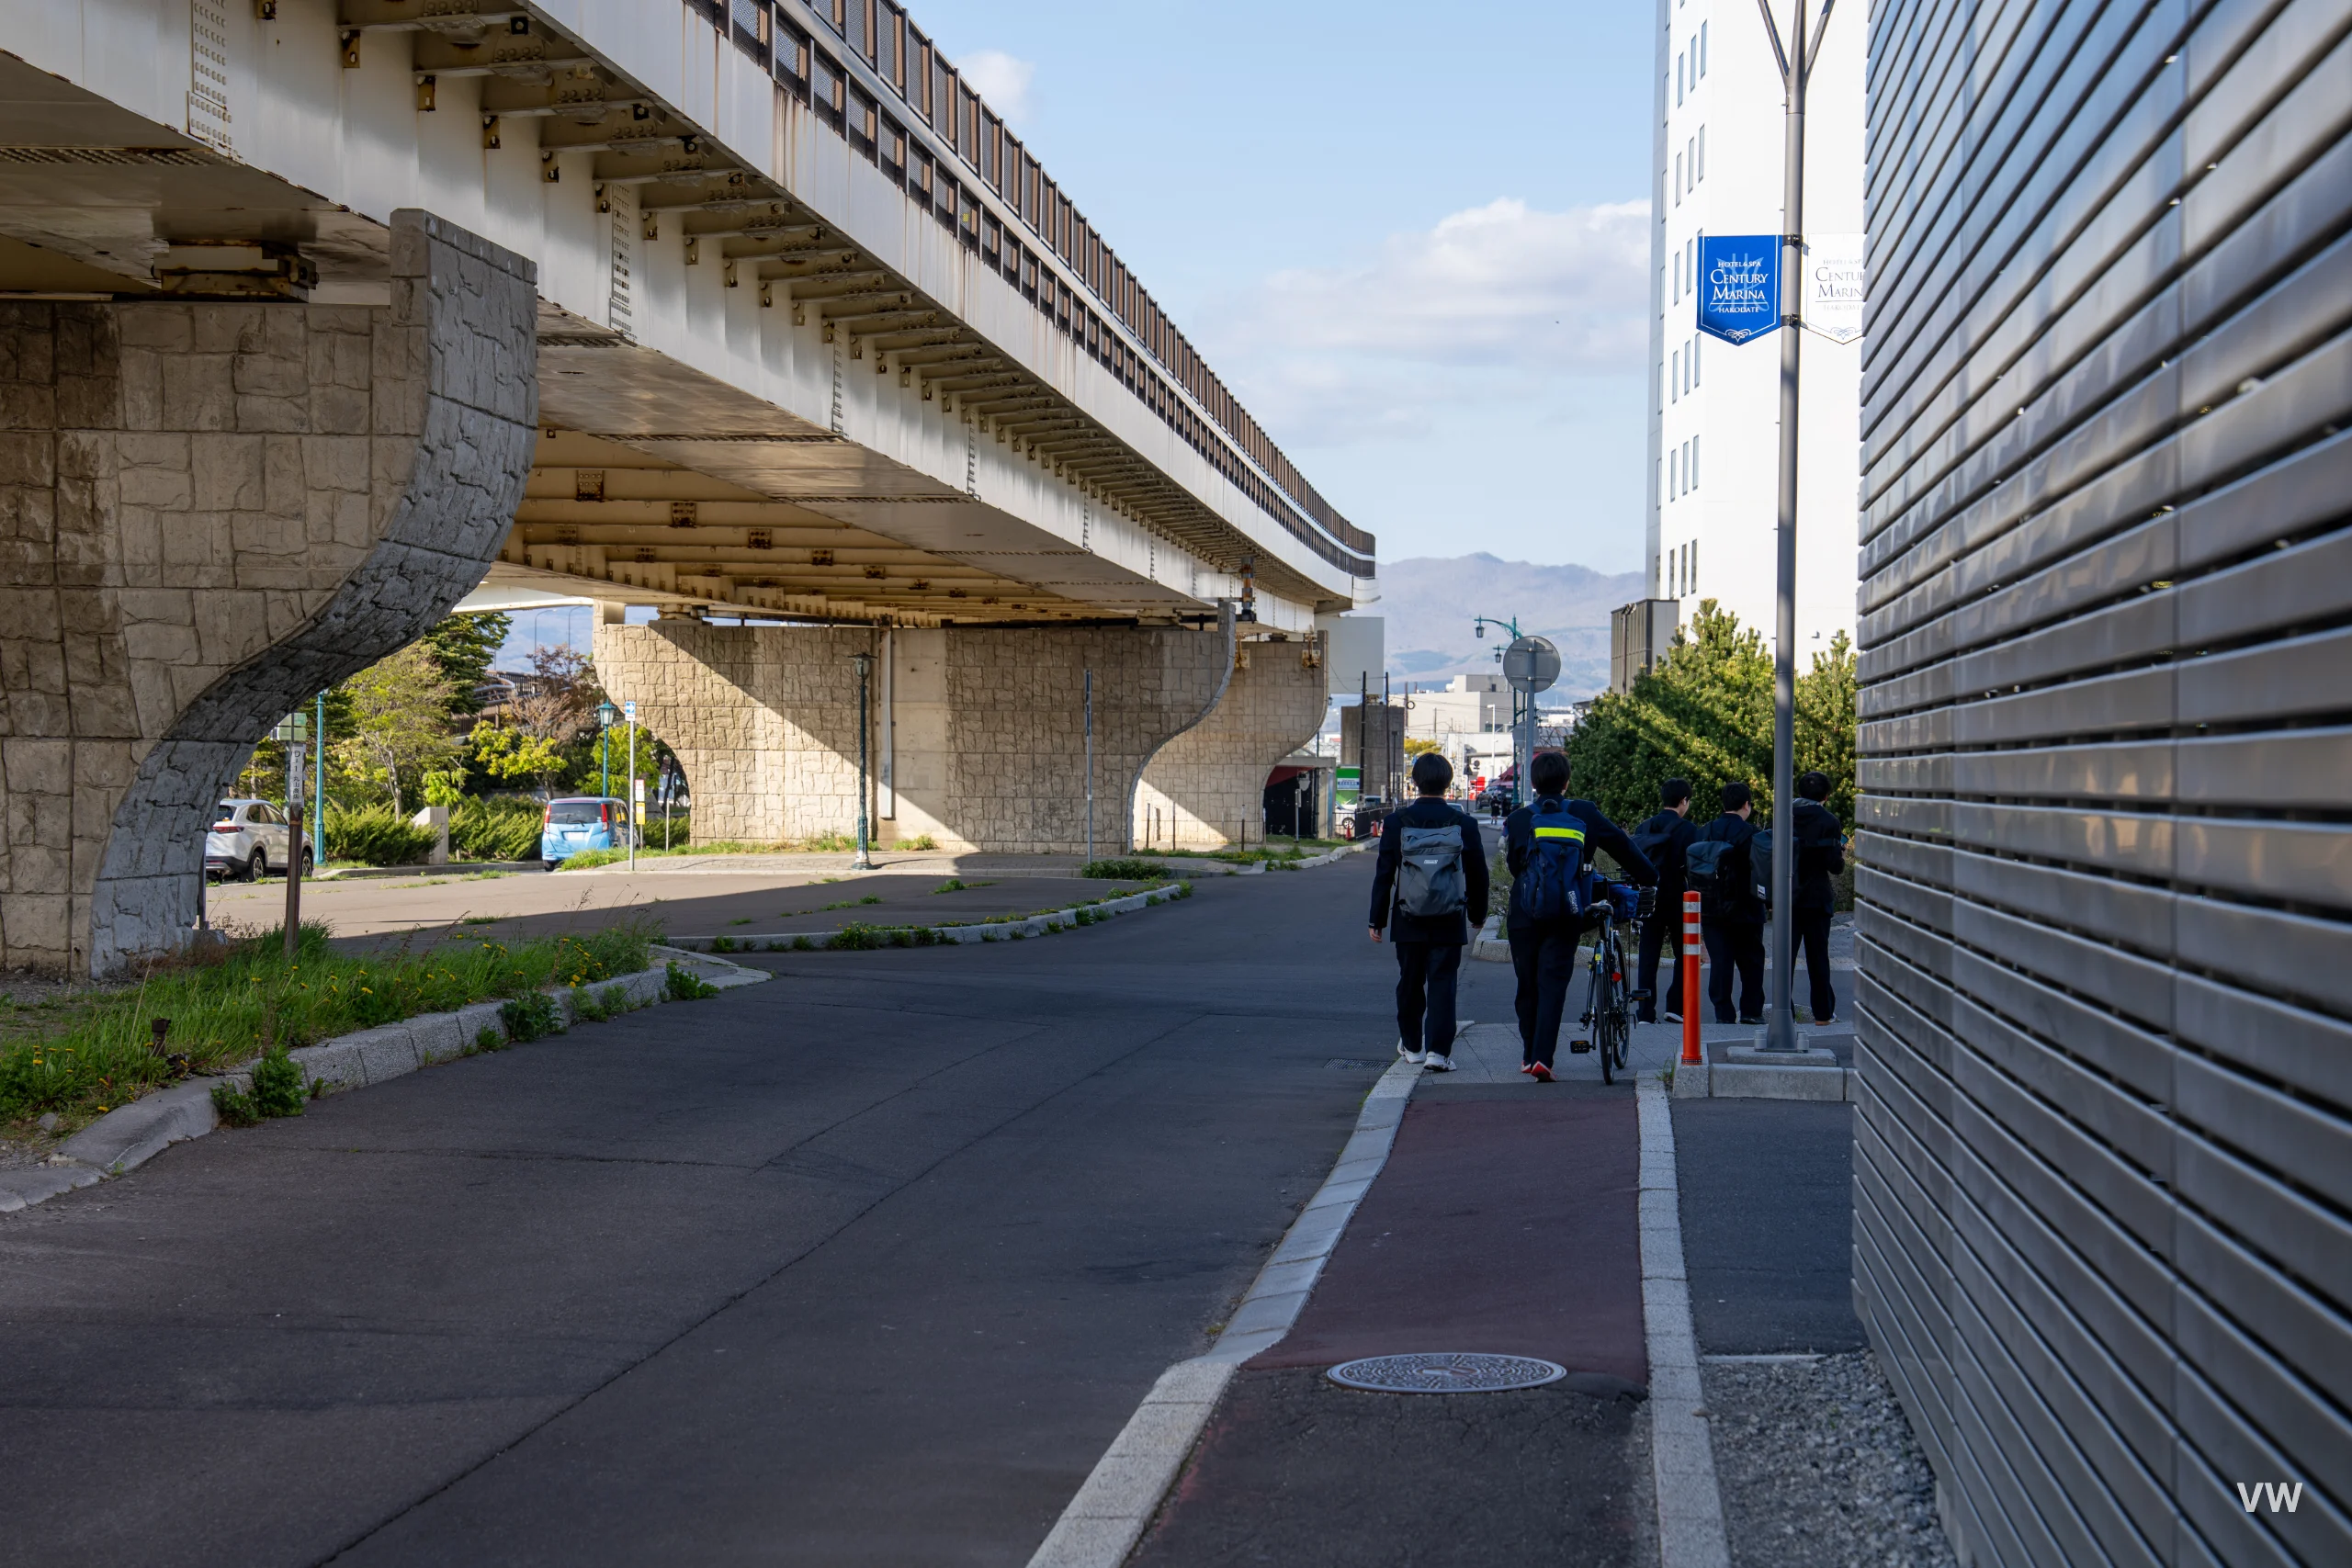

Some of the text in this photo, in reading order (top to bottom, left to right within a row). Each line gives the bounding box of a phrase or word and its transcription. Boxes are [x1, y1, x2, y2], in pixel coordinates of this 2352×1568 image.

[1710, 268, 1769, 284] CENTURY
[1713, 285, 1766, 300] MARINA
[1818, 283, 1863, 298] MARIN
